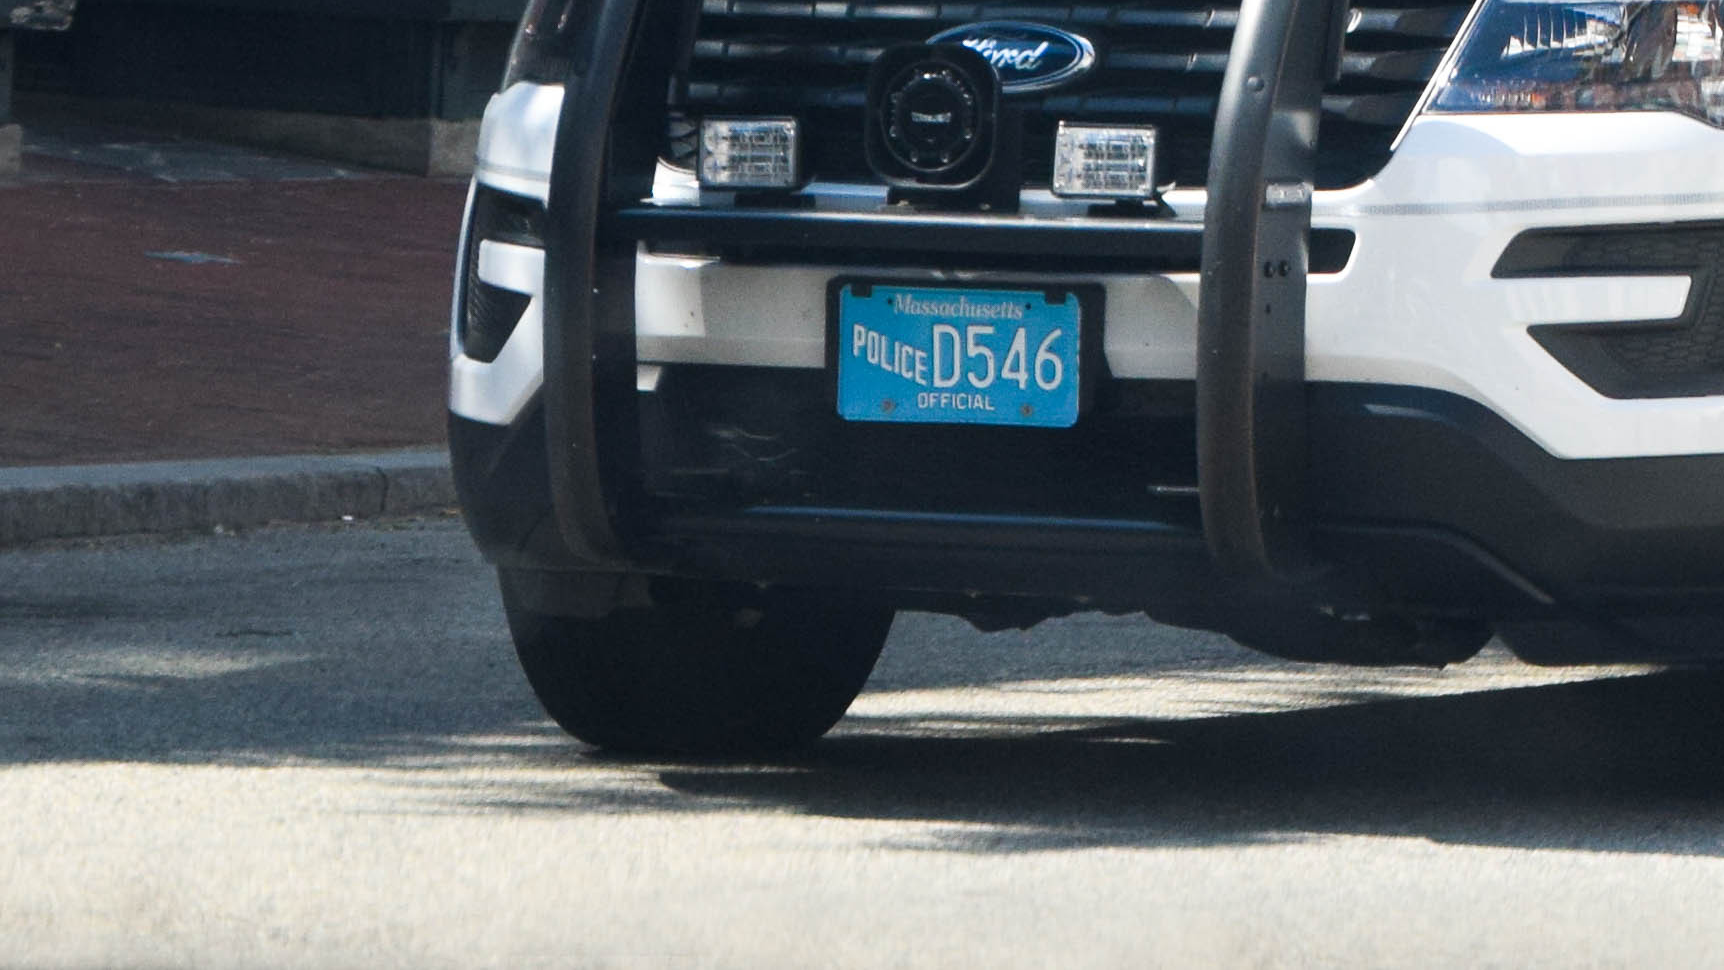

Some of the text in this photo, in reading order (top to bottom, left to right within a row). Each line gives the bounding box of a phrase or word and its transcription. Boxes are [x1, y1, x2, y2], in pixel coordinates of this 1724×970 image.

[893, 293, 1023, 320] Massachusetts
[853, 323, 1063, 391] POLICE D546
[917, 391, 995, 411] OFFICIAL
